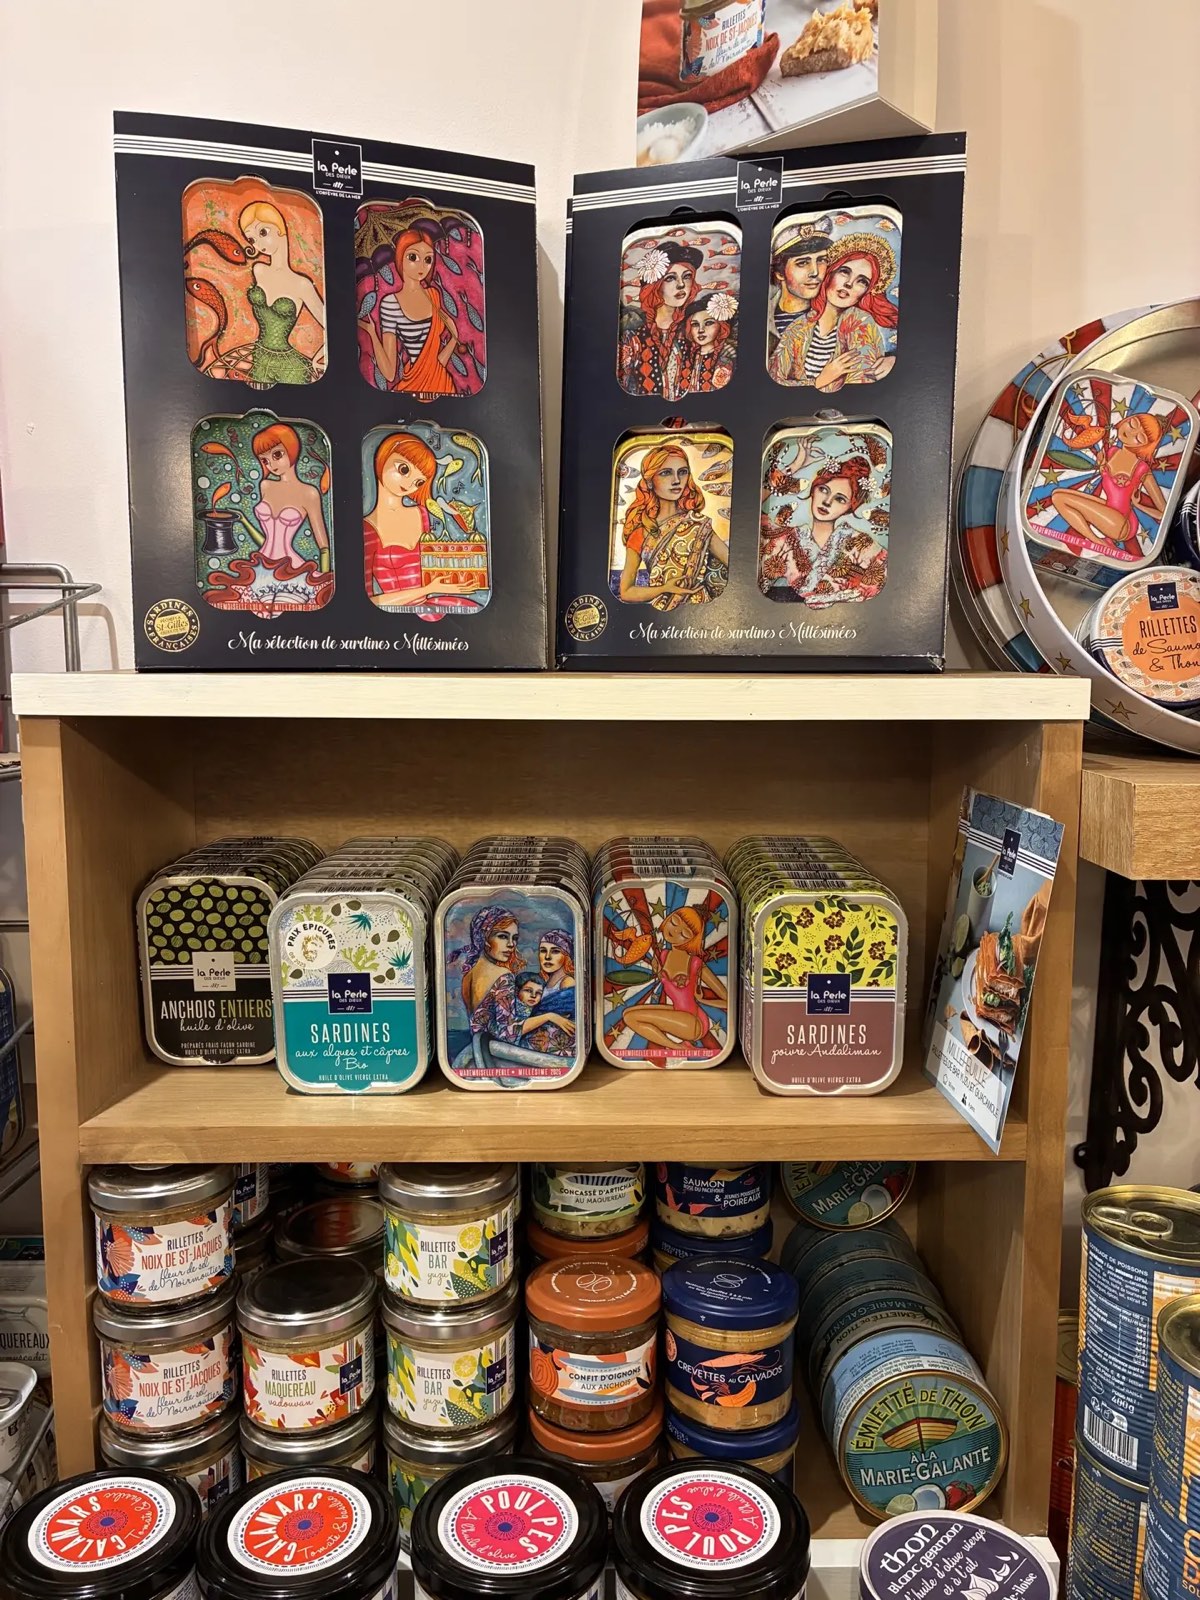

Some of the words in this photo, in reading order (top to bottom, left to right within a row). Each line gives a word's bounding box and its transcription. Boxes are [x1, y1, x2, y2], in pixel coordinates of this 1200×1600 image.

[722, 9, 746, 30] RILLETTES
[706, 36, 720, 52] NOIX
[720, 33, 728, 45] DE
[317, 160, 328, 172] la
[332, 162, 358, 176] Perle
[740, 180, 750, 190] la
[754, 178, 778, 188] Perle
[146, 601, 194, 626] SARDINES
[568, 596, 604, 619] SARDINES
[629, 622, 658, 644] Ma
[660, 624, 708, 640] sélection
[710, 625, 726, 640] de
[726, 625, 776, 640] sardines
[778, 622, 858, 644] Millésimées
[1139, 615, 1197, 638] RILLETTES
[148, 625, 198, 650] FRANÇAISES
[228, 631, 262, 654] Ma
[264, 634, 318, 650] sélection
[321, 635, 338, 650] de
[338, 635, 390, 650] sardines
[393, 632, 470, 656] Millésimées
[1133, 642, 1147, 656] de
[1147, 638, 1200, 654] Saumo
[1149, 658, 1164, 672] &
[1163, 654, 1200, 670] Thon
[288, 928, 301, 947] PRIX
[302, 924, 336, 950] EPICURES
[197, 968, 206, 976] la
[208, 968, 230, 976] Perle
[332, 990, 342, 998] la
[344, 990, 368, 998] Perle
[810, 990, 820, 999] la
[823, 990, 847, 999] Perle
[160, 999, 216, 1020] ANCHOIS
[220, 998, 272, 1018] ENTIERS
[180, 1018, 210, 1032] huile
[214, 1018, 254, 1031] d'olive
[310, 1022, 390, 1044] SARDINES
[787, 1024, 866, 1045] SARDINES
[185, 1048, 198, 1056] HUILE
[296, 1049, 318, 1058] aux
[323, 1044, 357, 1066] algues
[360, 1046, 372, 1056] et
[374, 1046, 410, 1064] câpres
[770, 1046, 806, 1064] poivre
[807, 1044, 882, 1057] Andaliman
[343, 1058, 368, 1070] Bio
[460, 1068, 494, 1077] MADEMOISELLE
[496, 1068, 510, 1076] PERLE
[518, 1067, 548, 1076] MILLÉSIME
[560, 1187, 597, 1196] CONCASSÉ
[683, 1176, 724, 1188] SAUMON
[586, 1192, 626, 1204] MAQUEREAU
[714, 1194, 722, 1202] &
[724, 1192, 761, 1208] POIREAUX
[167, 1230, 204, 1251] RILLETTES
[420, 1240, 456, 1253] RILLETTES
[142, 1254, 163, 1270] NOIX
[166, 1252, 176, 1267] DE
[178, 1234, 222, 1265] ST-JACQUES
[428, 1254, 448, 1269] BAR
[160, 1266, 186, 1289] fleur
[187, 1262, 198, 1274] de
[198, 1256, 209, 1270] sel
[1118, 1260, 1148, 1277] POISSONS
[148, 1280, 160, 1292] de
[0, 1332, 50, 1350] QUEREAU
[139, 1382, 160, 1398] NOIX
[162, 1380, 173, 1395] DE
[176, 1361, 221, 1392] ST-JACQUES
[164, 1360, 200, 1380] RILLETTES
[272, 1369, 306, 1382] RILLETTES
[417, 1366, 450, 1380] RILLETTES
[569, 1372, 598, 1382] CONFIT
[600, 1367, 641, 1382] D'OIGNONS
[677, 1360, 726, 1382] CREVETTES
[738, 1365, 783, 1384] CALVADOS
[265, 1380, 316, 1398] MAQUEREAU
[424, 1381, 442, 1396] BAR
[581, 1382, 596, 1390] AUX
[598, 1378, 631, 1390] ANCHOIS
[146, 1407, 157, 1418] de
[162, 1391, 220, 1416] Noirmoutier
[157, 1394, 182, 1415] fleur
[184, 1390, 194, 1402] de
[195, 1384, 207, 1398] sel
[268, 1398, 314, 1408] vadouvan
[850, 1382, 916, 1450] ÉMIETTÉ
[920, 1390, 938, 1402] DE
[941, 1386, 986, 1431] THON
[860, 1446, 991, 1486] MARIE-GALANTE
[910, 1452, 920, 1464] À
[922, 1451, 938, 1462] LA
[51, 1495, 127, 1558] CALAMARS
[249, 1492, 322, 1562] CALAMARS
[480, 1490, 558, 1554] POULPES
[661, 1496, 752, 1556] POULPES
[298, 1533, 341, 1560] Tomate
[332, 1521, 348, 1533] &
[880, 1523, 940, 1574] thon
[920, 1522, 964, 1568] germon
[476, 1545, 518, 1560] d'olive
[936, 1550, 964, 1580] d'olive
[962, 1528, 988, 1552] vierge
[943, 1584, 954, 1596] et
[957, 1558, 980, 1580] l'ail
